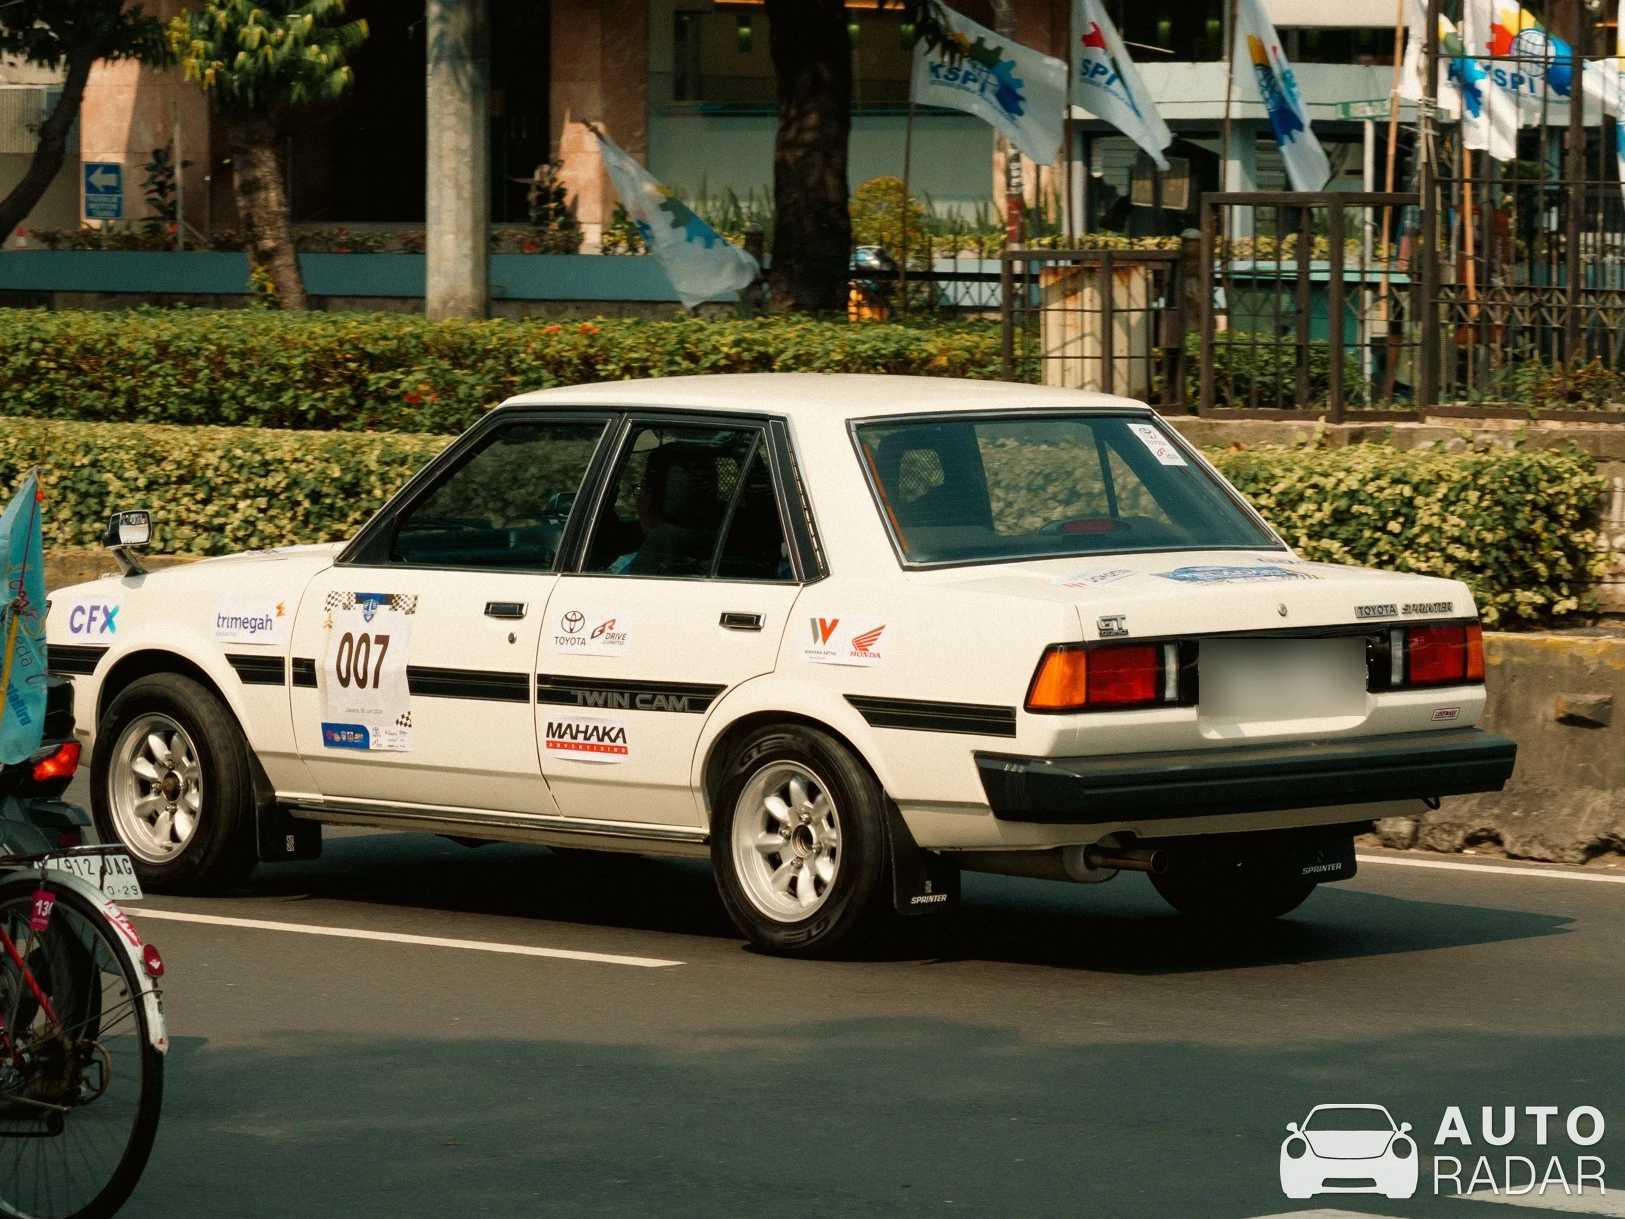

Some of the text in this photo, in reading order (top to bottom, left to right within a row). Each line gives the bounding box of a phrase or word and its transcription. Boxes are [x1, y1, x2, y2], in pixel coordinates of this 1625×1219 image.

[1081, 58, 1117, 86] SPI
[1357, 602, 1454, 616] TOYOTA SPRINTER
[69, 604, 120, 634] CFX
[216, 612, 273, 634] trimegah
[554, 636, 586, 647] TOYOTA
[605, 632, 628, 641] DRIVE
[336, 631, 390, 690] 007
[850, 650, 882, 659] HONDA
[570, 690, 688, 711] TWIN CAM
[545, 721, 628, 744] MAHAKA
[548, 743, 627, 754] ADVERTISING
[1301, 862, 1342, 875] SPRINTER
[910, 893, 948, 905] SPRINTER
